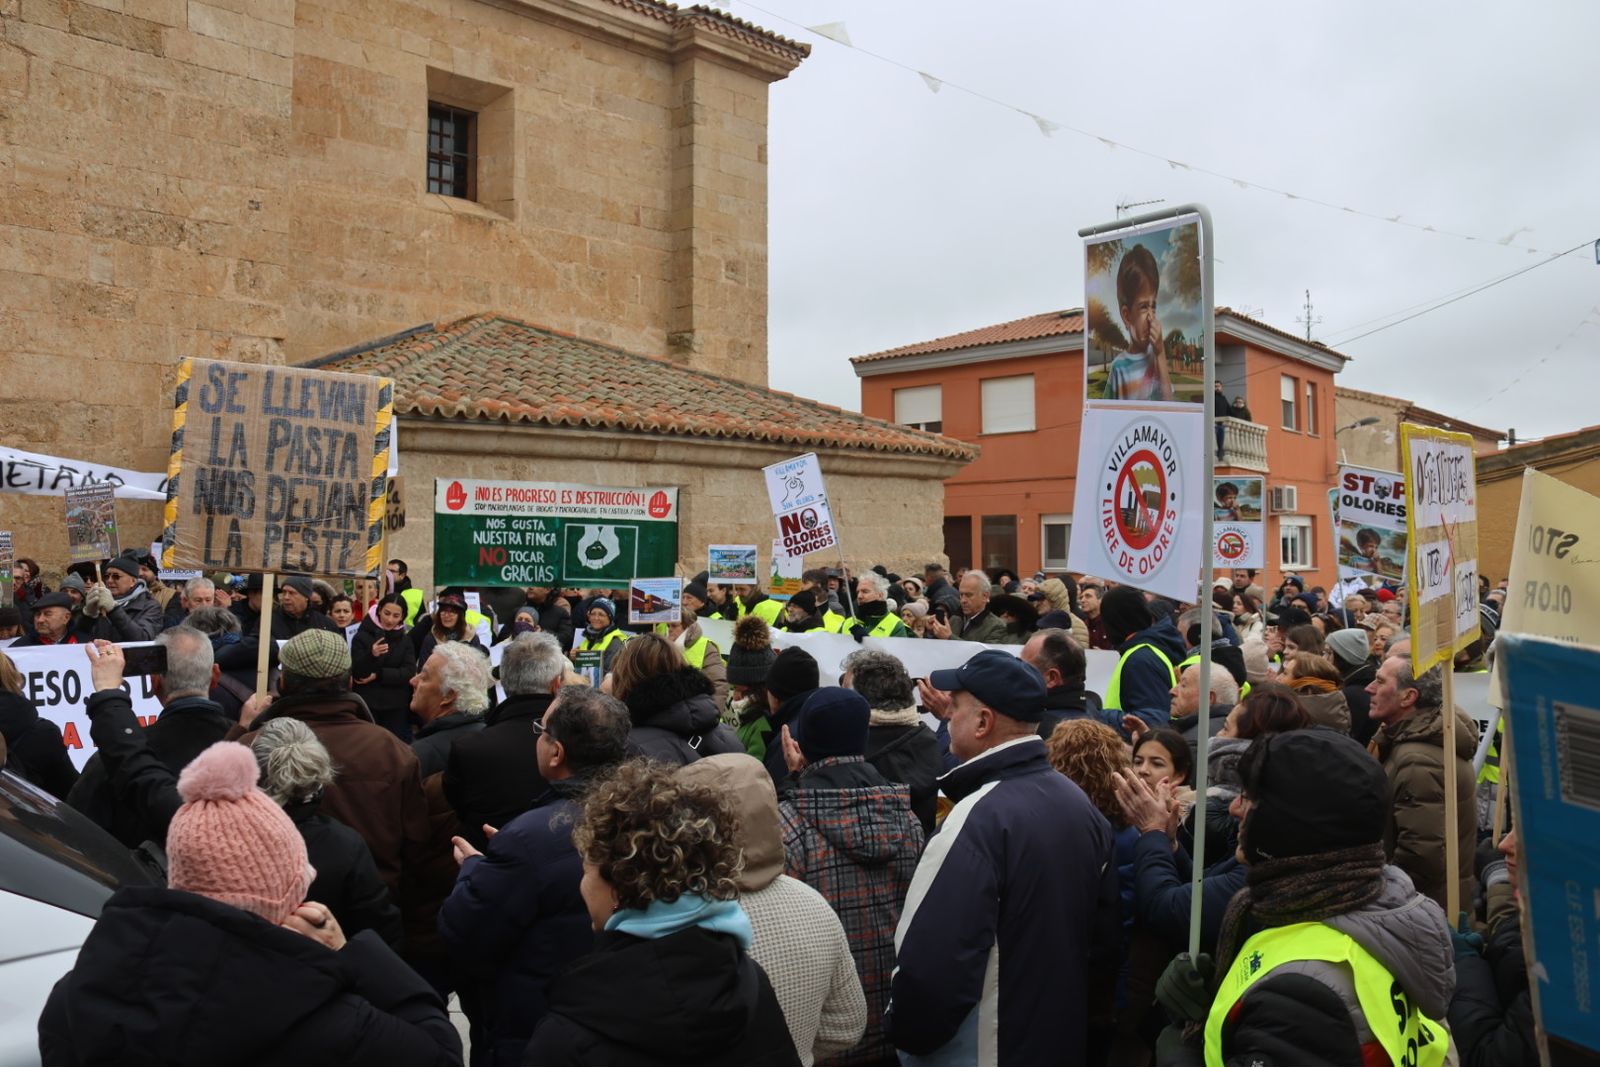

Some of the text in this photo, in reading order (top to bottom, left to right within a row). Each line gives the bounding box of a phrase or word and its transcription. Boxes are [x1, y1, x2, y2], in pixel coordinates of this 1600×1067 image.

[200, 363, 367, 425] SE LLEVAN
[209, 416, 358, 479] LA PASTA
[1108, 425, 1177, 477] VILLAMAYOR
[192, 467, 367, 532] NOS DEJAN
[492, 487, 502, 502] ES
[561, 490, 572, 505] ES
[1342, 494, 1407, 518] OLORES
[486, 518, 546, 531] NOS GUSTA
[784, 524, 831, 548] OLORES
[1102, 498, 1177, 575] LIBRE DE OLORES
[203, 516, 361, 575] LA PESTE
[473, 530, 557, 546] NUESTRA FINCA
[786, 536, 833, 558] TOXICOS
[479, 546, 545, 567] NO TOCAR
[501, 564, 554, 582] GRACIAS
